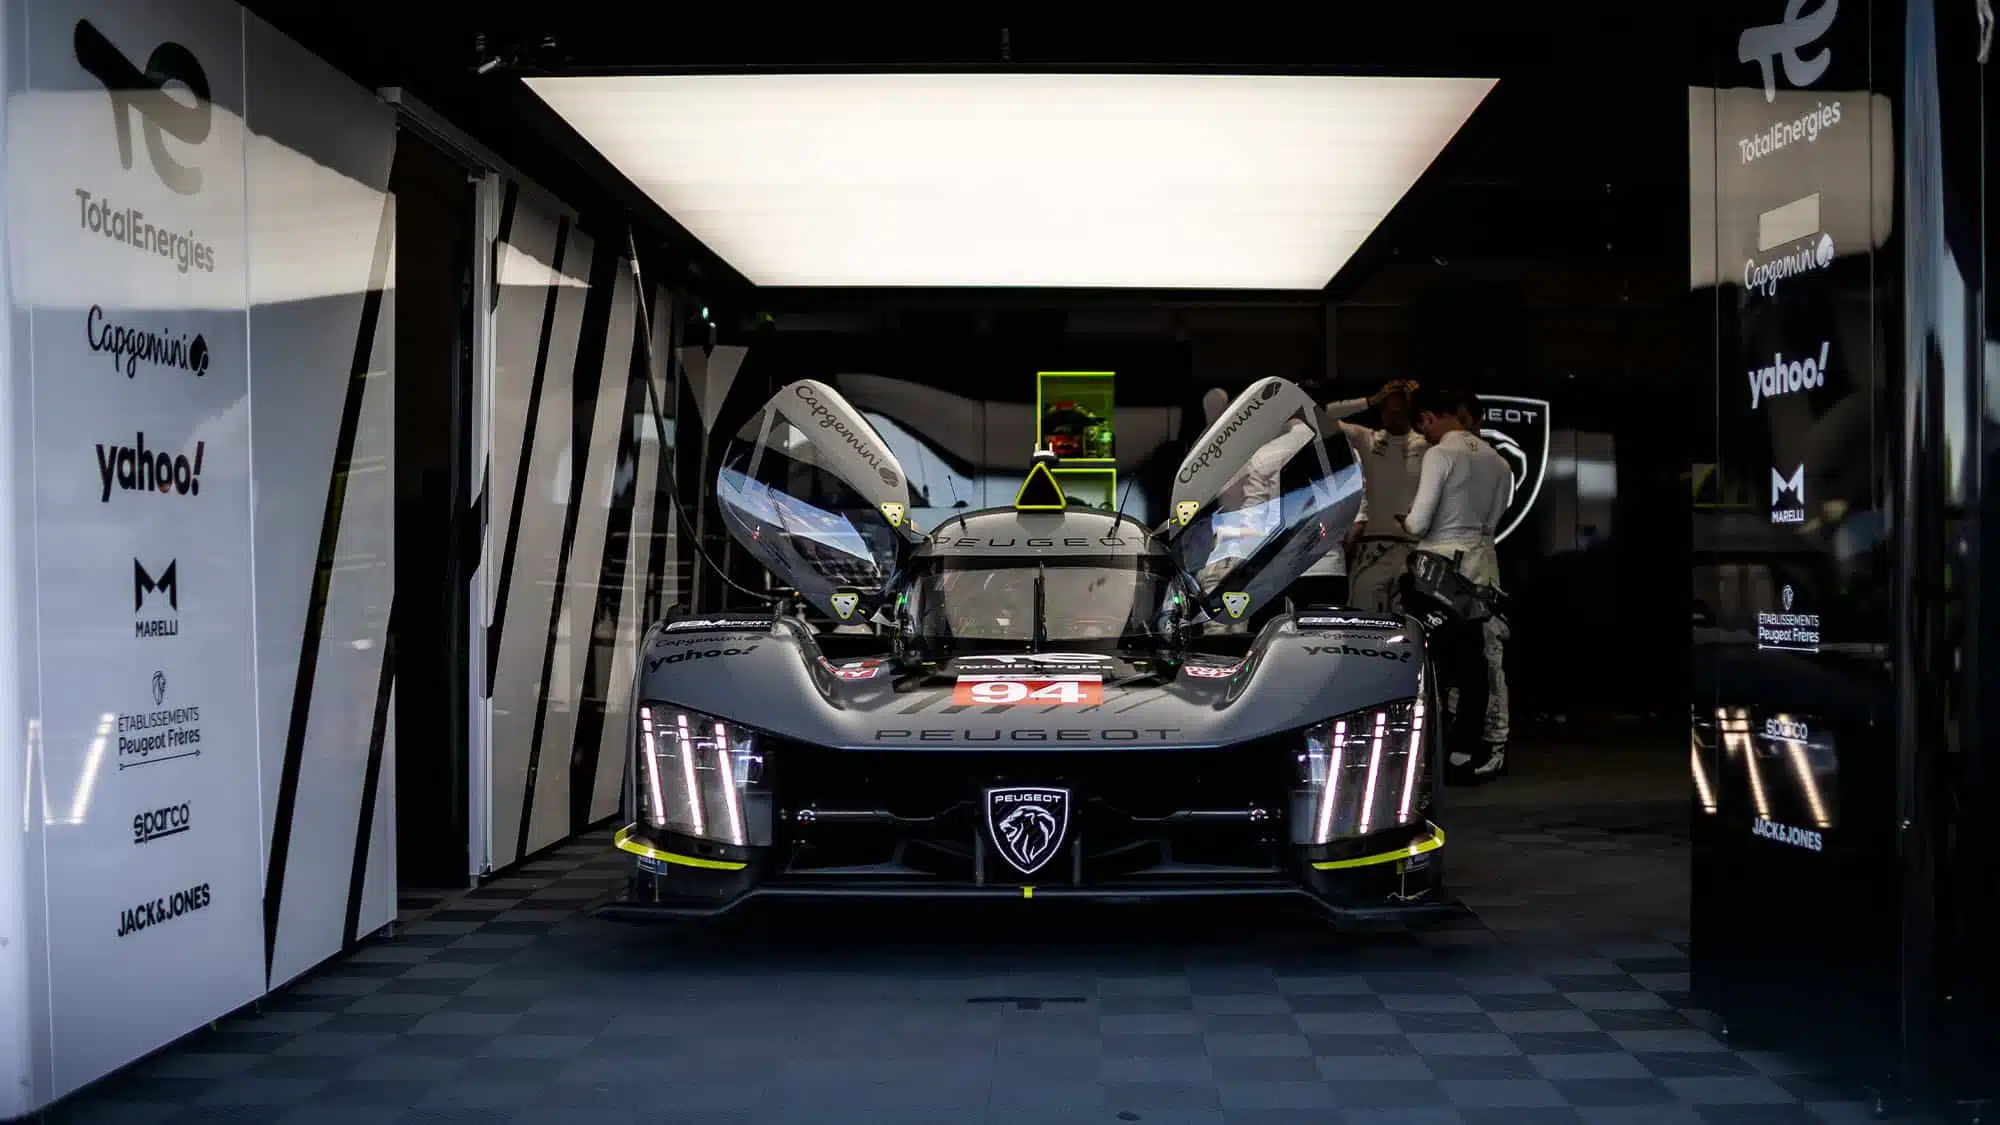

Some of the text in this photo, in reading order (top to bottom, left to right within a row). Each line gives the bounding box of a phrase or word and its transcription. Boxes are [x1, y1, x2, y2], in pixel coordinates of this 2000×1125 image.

[1738, 101, 1841, 165] TotalEnergies
[75, 188, 215, 273] TotalEnergies
[1744, 242, 1817, 297] Capgemini
[87, 304, 188, 379] Capgemini
[1748, 341, 1830, 410] yahoo!
[795, 384, 881, 471] Capgemini
[1177, 398, 1264, 485] Capgemini
[96, 432, 205, 502] yahoo!
[1771, 508, 1805, 524] MARELLI
[135, 619, 179, 639] MARELLI
[1758, 626, 1792, 643] Peugeot
[970, 681, 1088, 703] 94
[118, 727, 200, 757] Peugeot Frères
[874, 729, 1181, 742] PEUGEOT
[994, 793, 1062, 804] PEUGEOT
[133, 802, 191, 844] sparco
[1752, 816, 1823, 852] JACK&JONES
[117, 882, 211, 937] JACK&JONES
